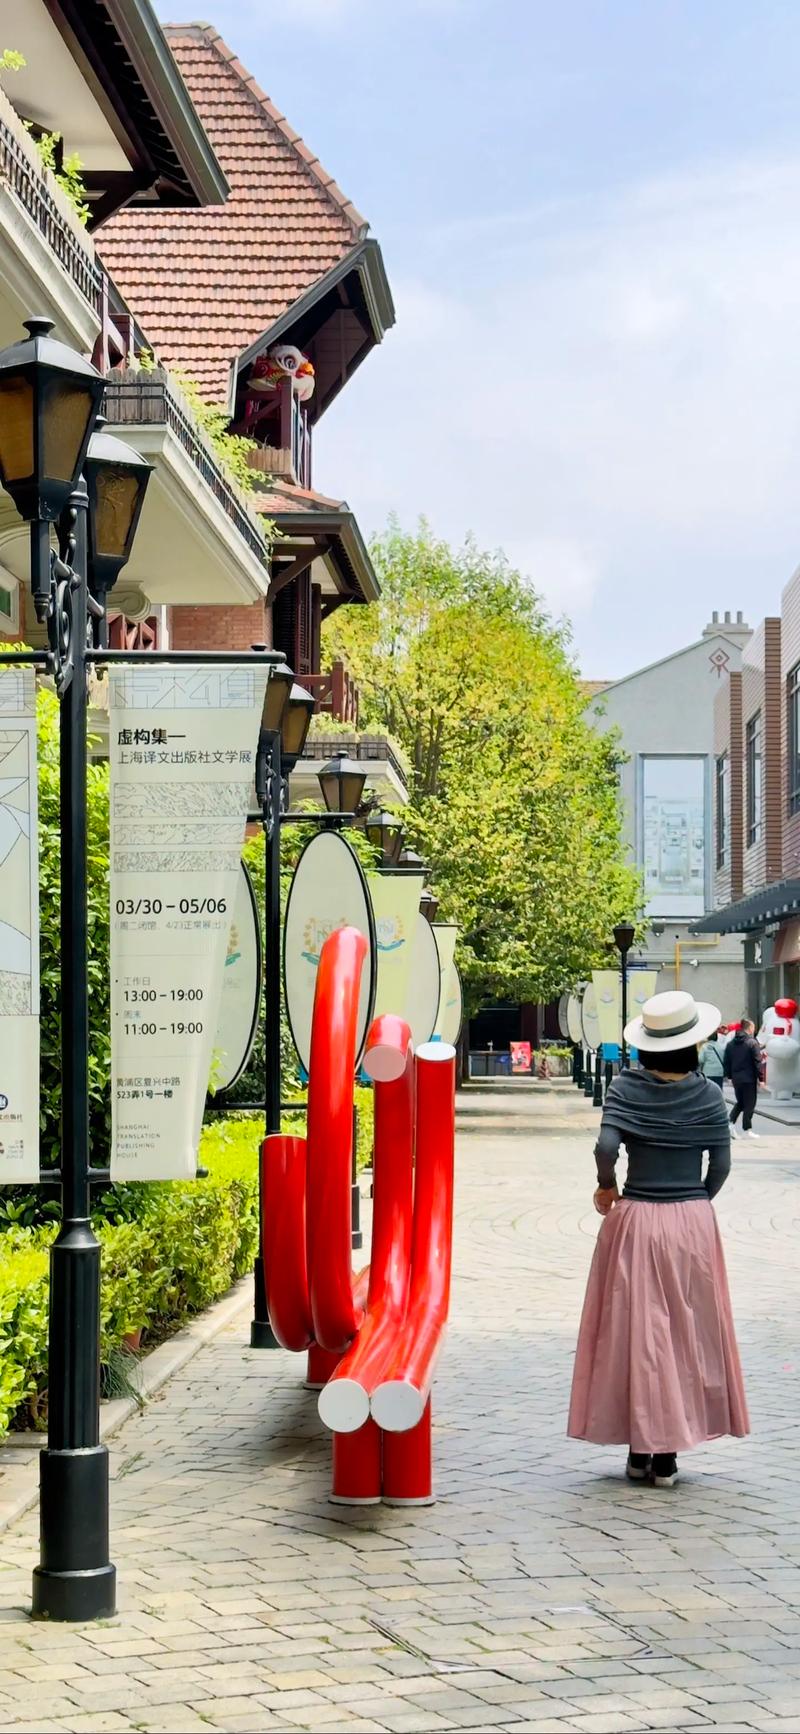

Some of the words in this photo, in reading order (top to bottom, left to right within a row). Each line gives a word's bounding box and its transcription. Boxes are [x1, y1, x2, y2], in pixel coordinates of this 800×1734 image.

[118, 750, 252, 764] 上海译文出版社文学展
[116, 899, 162, 914] 03/30
[180, 898, 227, 913] 05/06
[124, 976, 151, 986] 工作日
[124, 990, 157, 1002] 13:00
[170, 989, 203, 1001] 19:00
[124, 1023, 157, 1035] 11:00
[170, 1022, 203, 1034] 19:00
[116, 1076, 181, 1087] 黄浦区复兴中路
